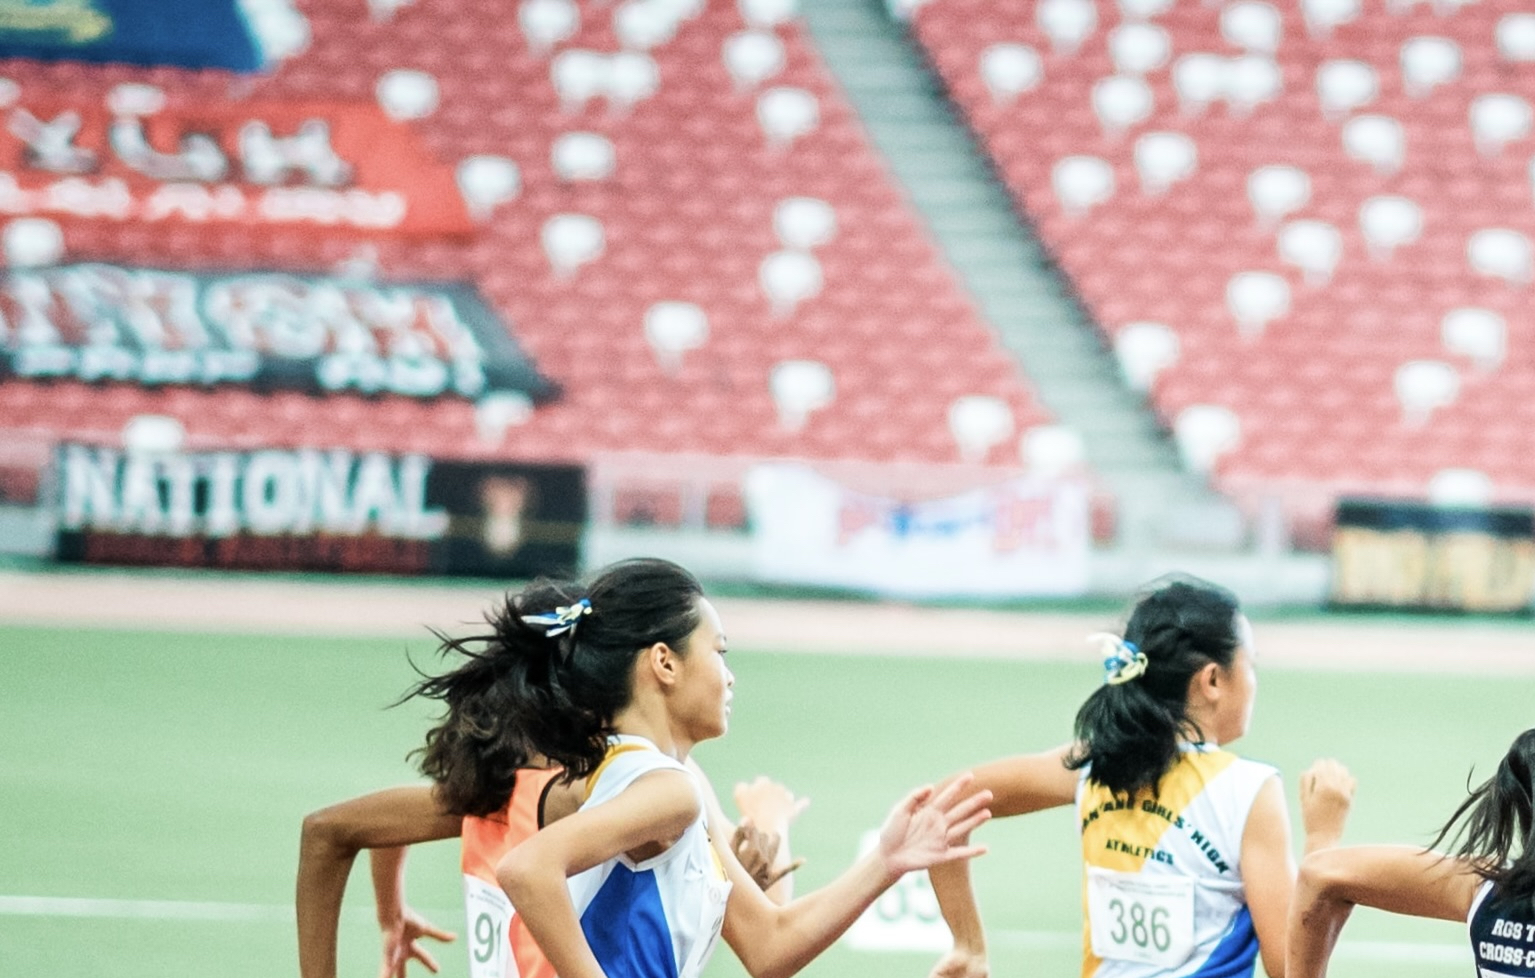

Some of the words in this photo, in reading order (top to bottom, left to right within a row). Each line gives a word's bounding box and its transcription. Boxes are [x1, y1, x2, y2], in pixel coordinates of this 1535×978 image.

[63, 447, 450, 539] NATIONAL
[1105, 838, 1175, 866] ATHLETICS
[1190, 829, 1230, 875] HIGH
[1108, 897, 1172, 953] 386
[1491, 918, 1523, 940] RGS
